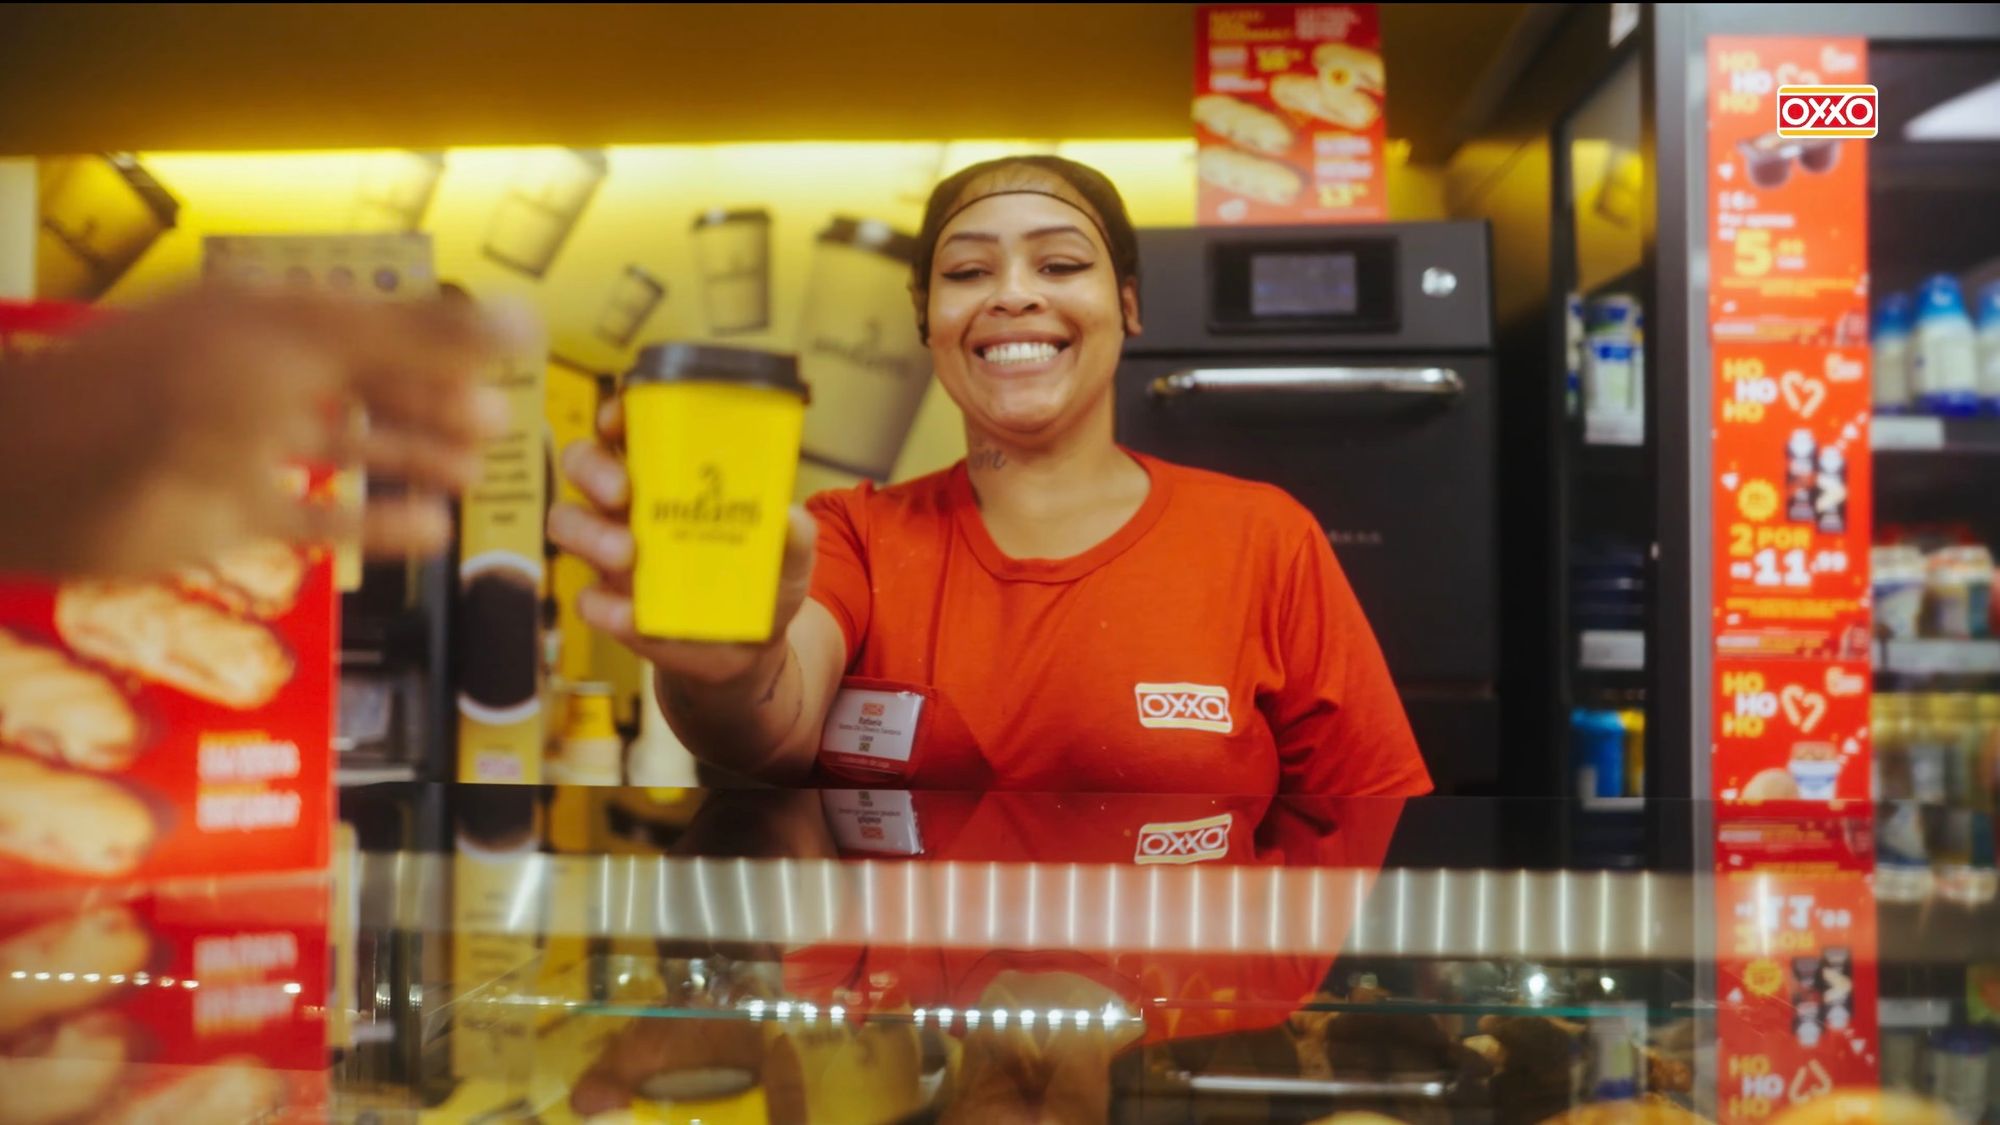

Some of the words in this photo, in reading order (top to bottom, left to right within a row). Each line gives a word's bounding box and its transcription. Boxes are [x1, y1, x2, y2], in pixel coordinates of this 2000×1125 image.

[1731, 70, 1773, 95] HO
[1722, 357, 1764, 382] HO
[1735, 378, 1778, 404] HO
[1722, 399, 1764, 423] HO
[1729, 523, 1753, 556] 2
[1757, 526, 1812, 550] POR
[1721, 672, 1764, 696] HO
[1142, 693, 1225, 721] OXXO
[1735, 691, 1778, 717] HO
[1721, 713, 1764, 738] HO
